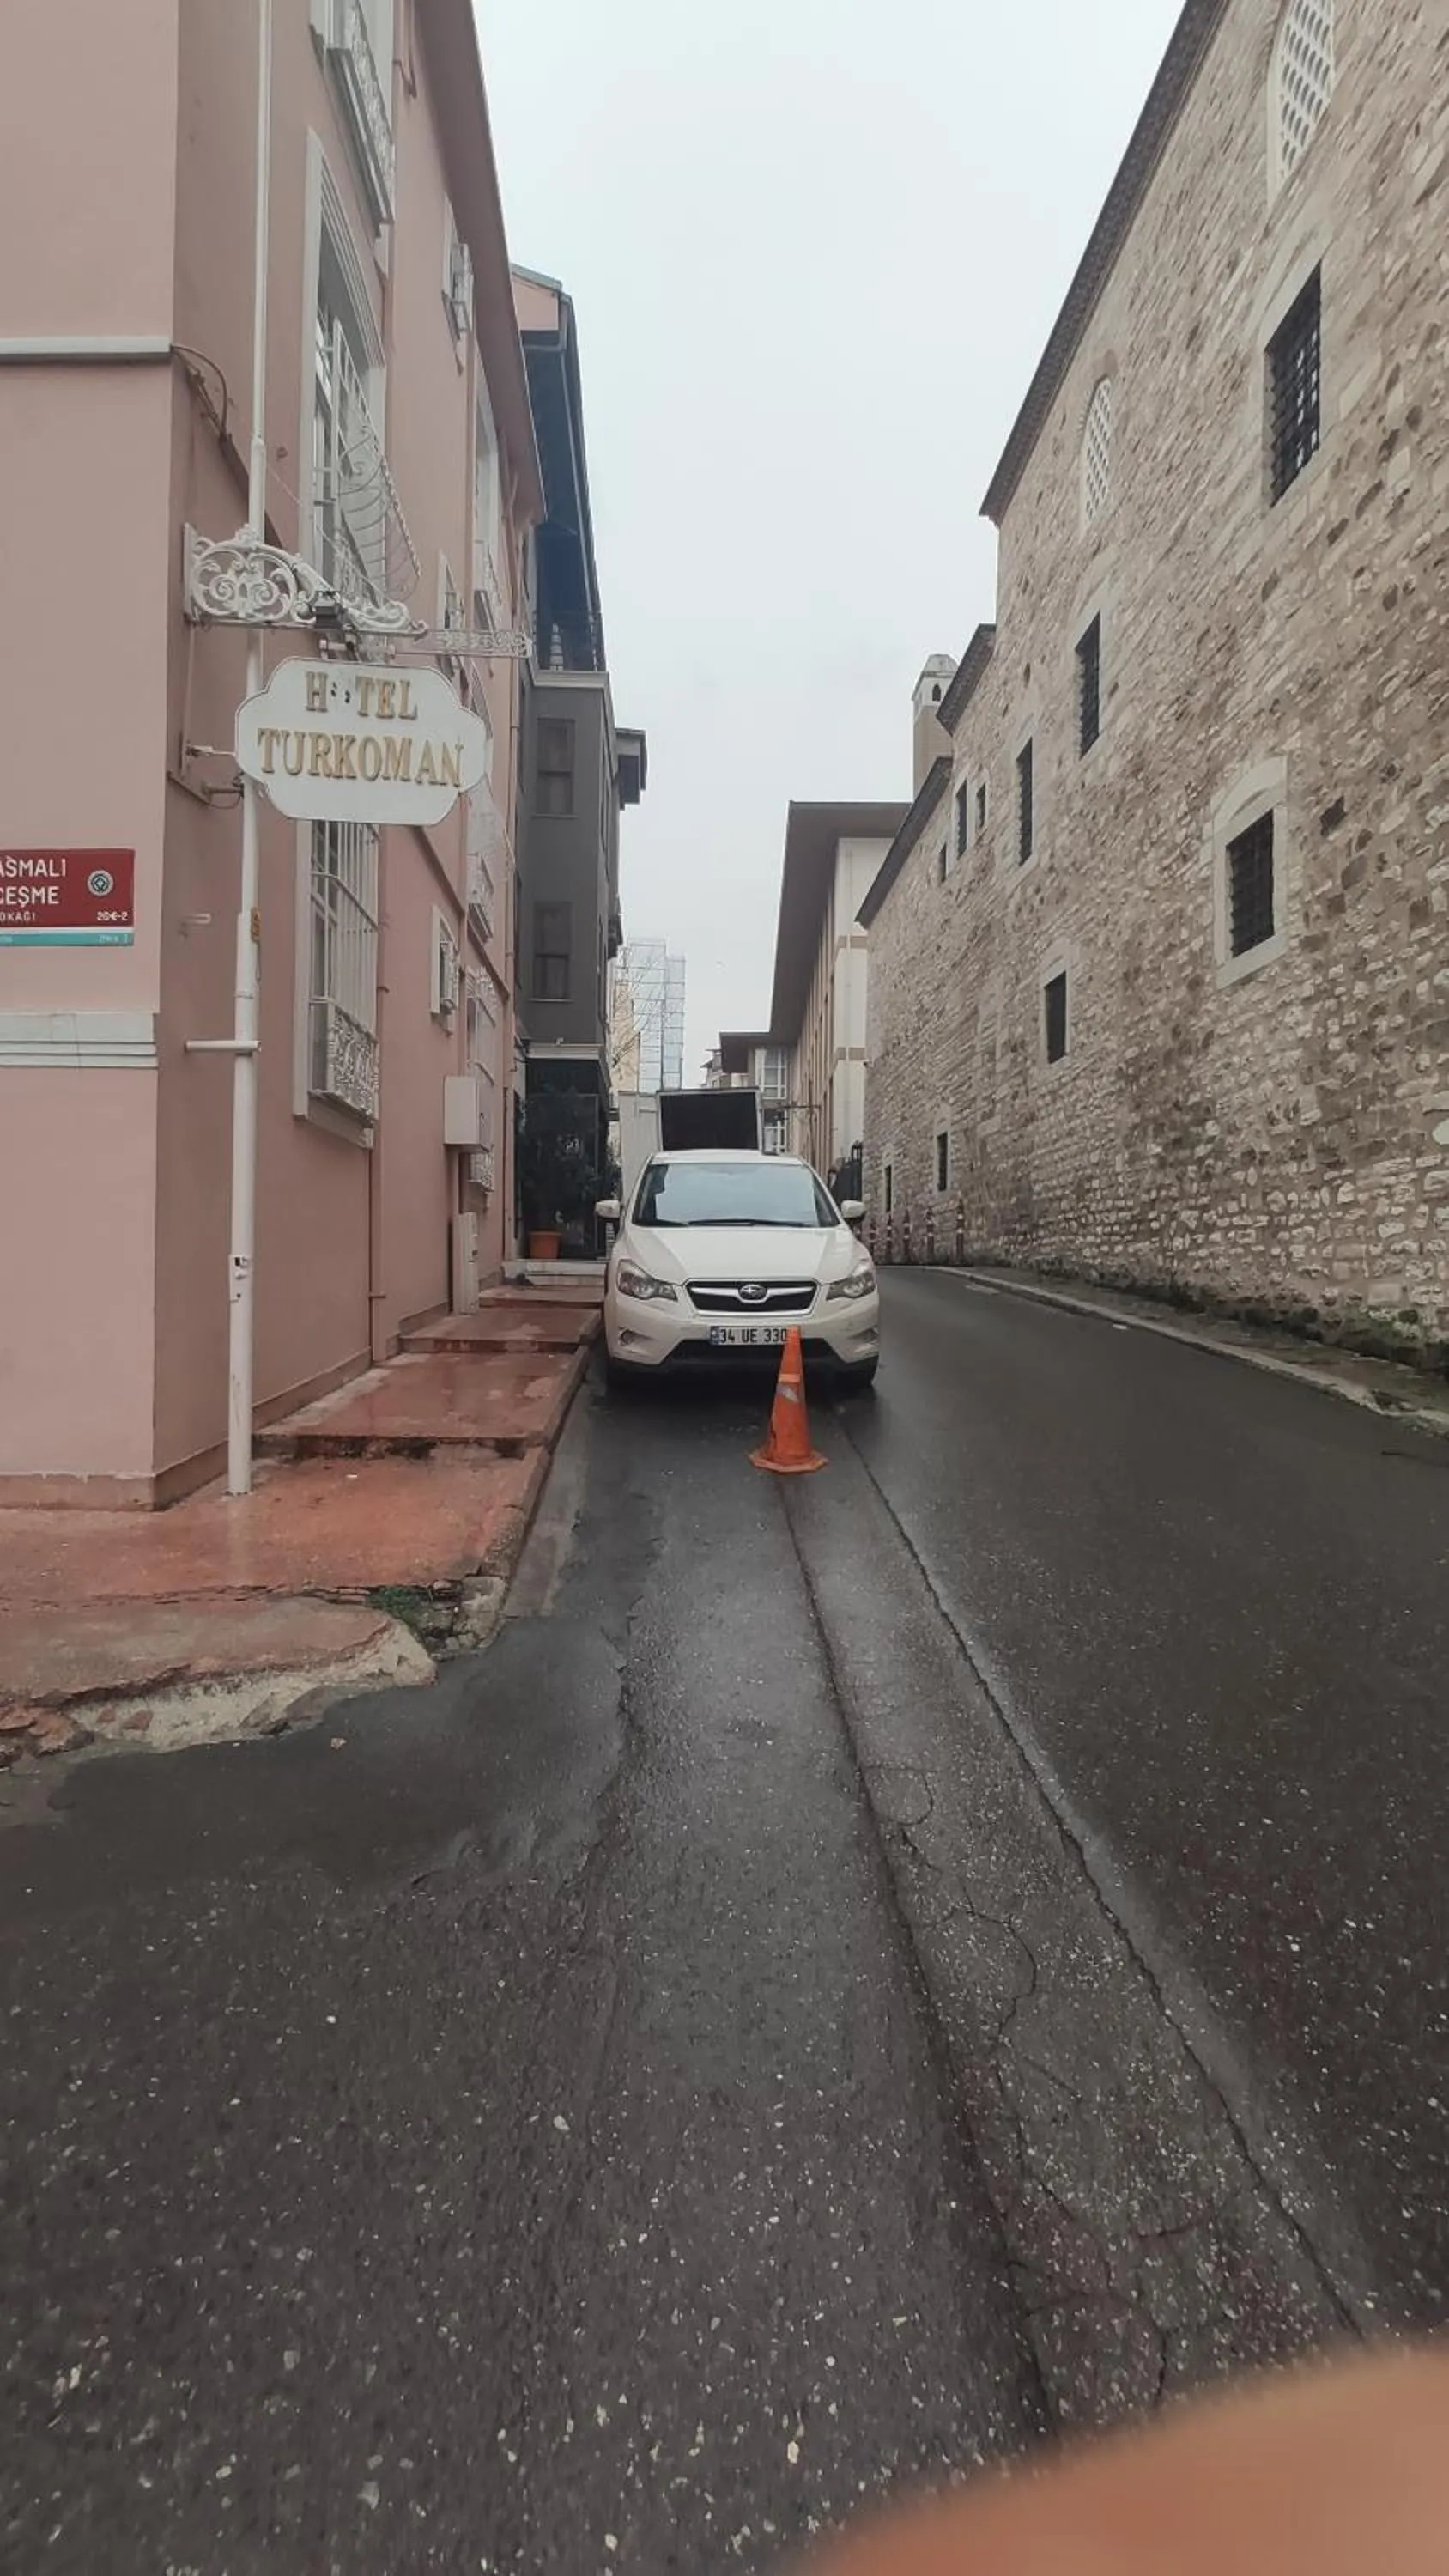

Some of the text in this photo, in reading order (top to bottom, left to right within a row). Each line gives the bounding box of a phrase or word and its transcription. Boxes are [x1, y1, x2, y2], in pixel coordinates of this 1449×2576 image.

[305, 671, 417, 720] HTEL
[258, 728, 464, 787] TURKOMAN
[742, 1328, 758, 1343] UE
